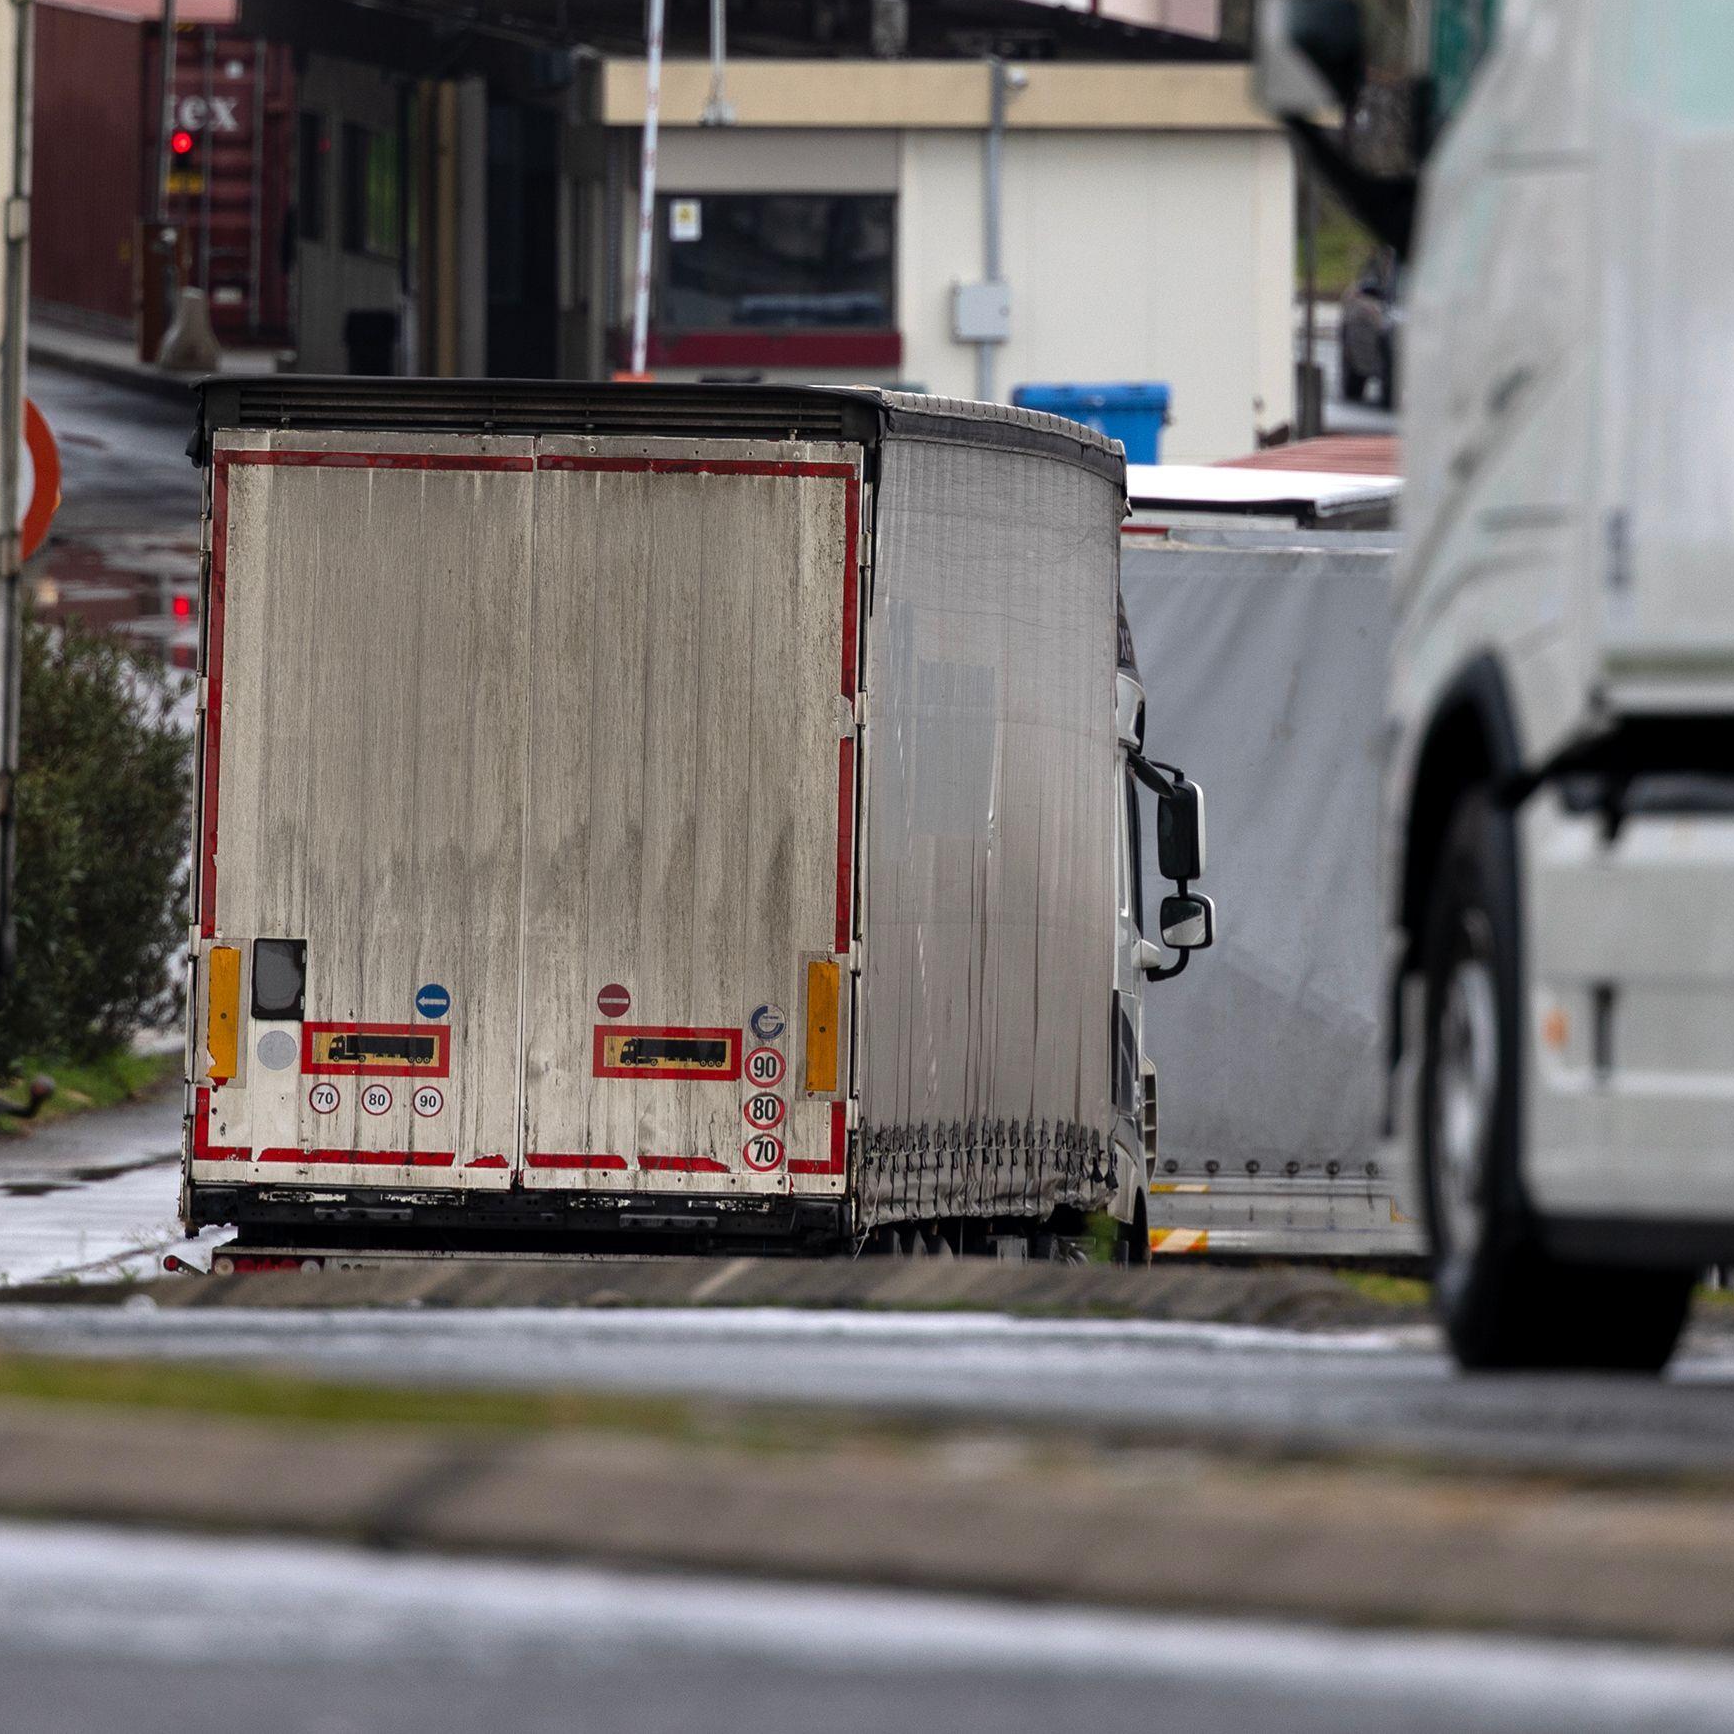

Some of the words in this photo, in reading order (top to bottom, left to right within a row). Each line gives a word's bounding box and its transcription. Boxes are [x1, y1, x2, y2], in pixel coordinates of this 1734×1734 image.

[753, 1056, 777, 1078] 90
[317, 1091, 334, 1106] 70
[368, 1092, 385, 1107] 80
[419, 1093, 437, 1109] 90
[752, 1098, 777, 1121] 80
[753, 1139, 776, 1163] 70
